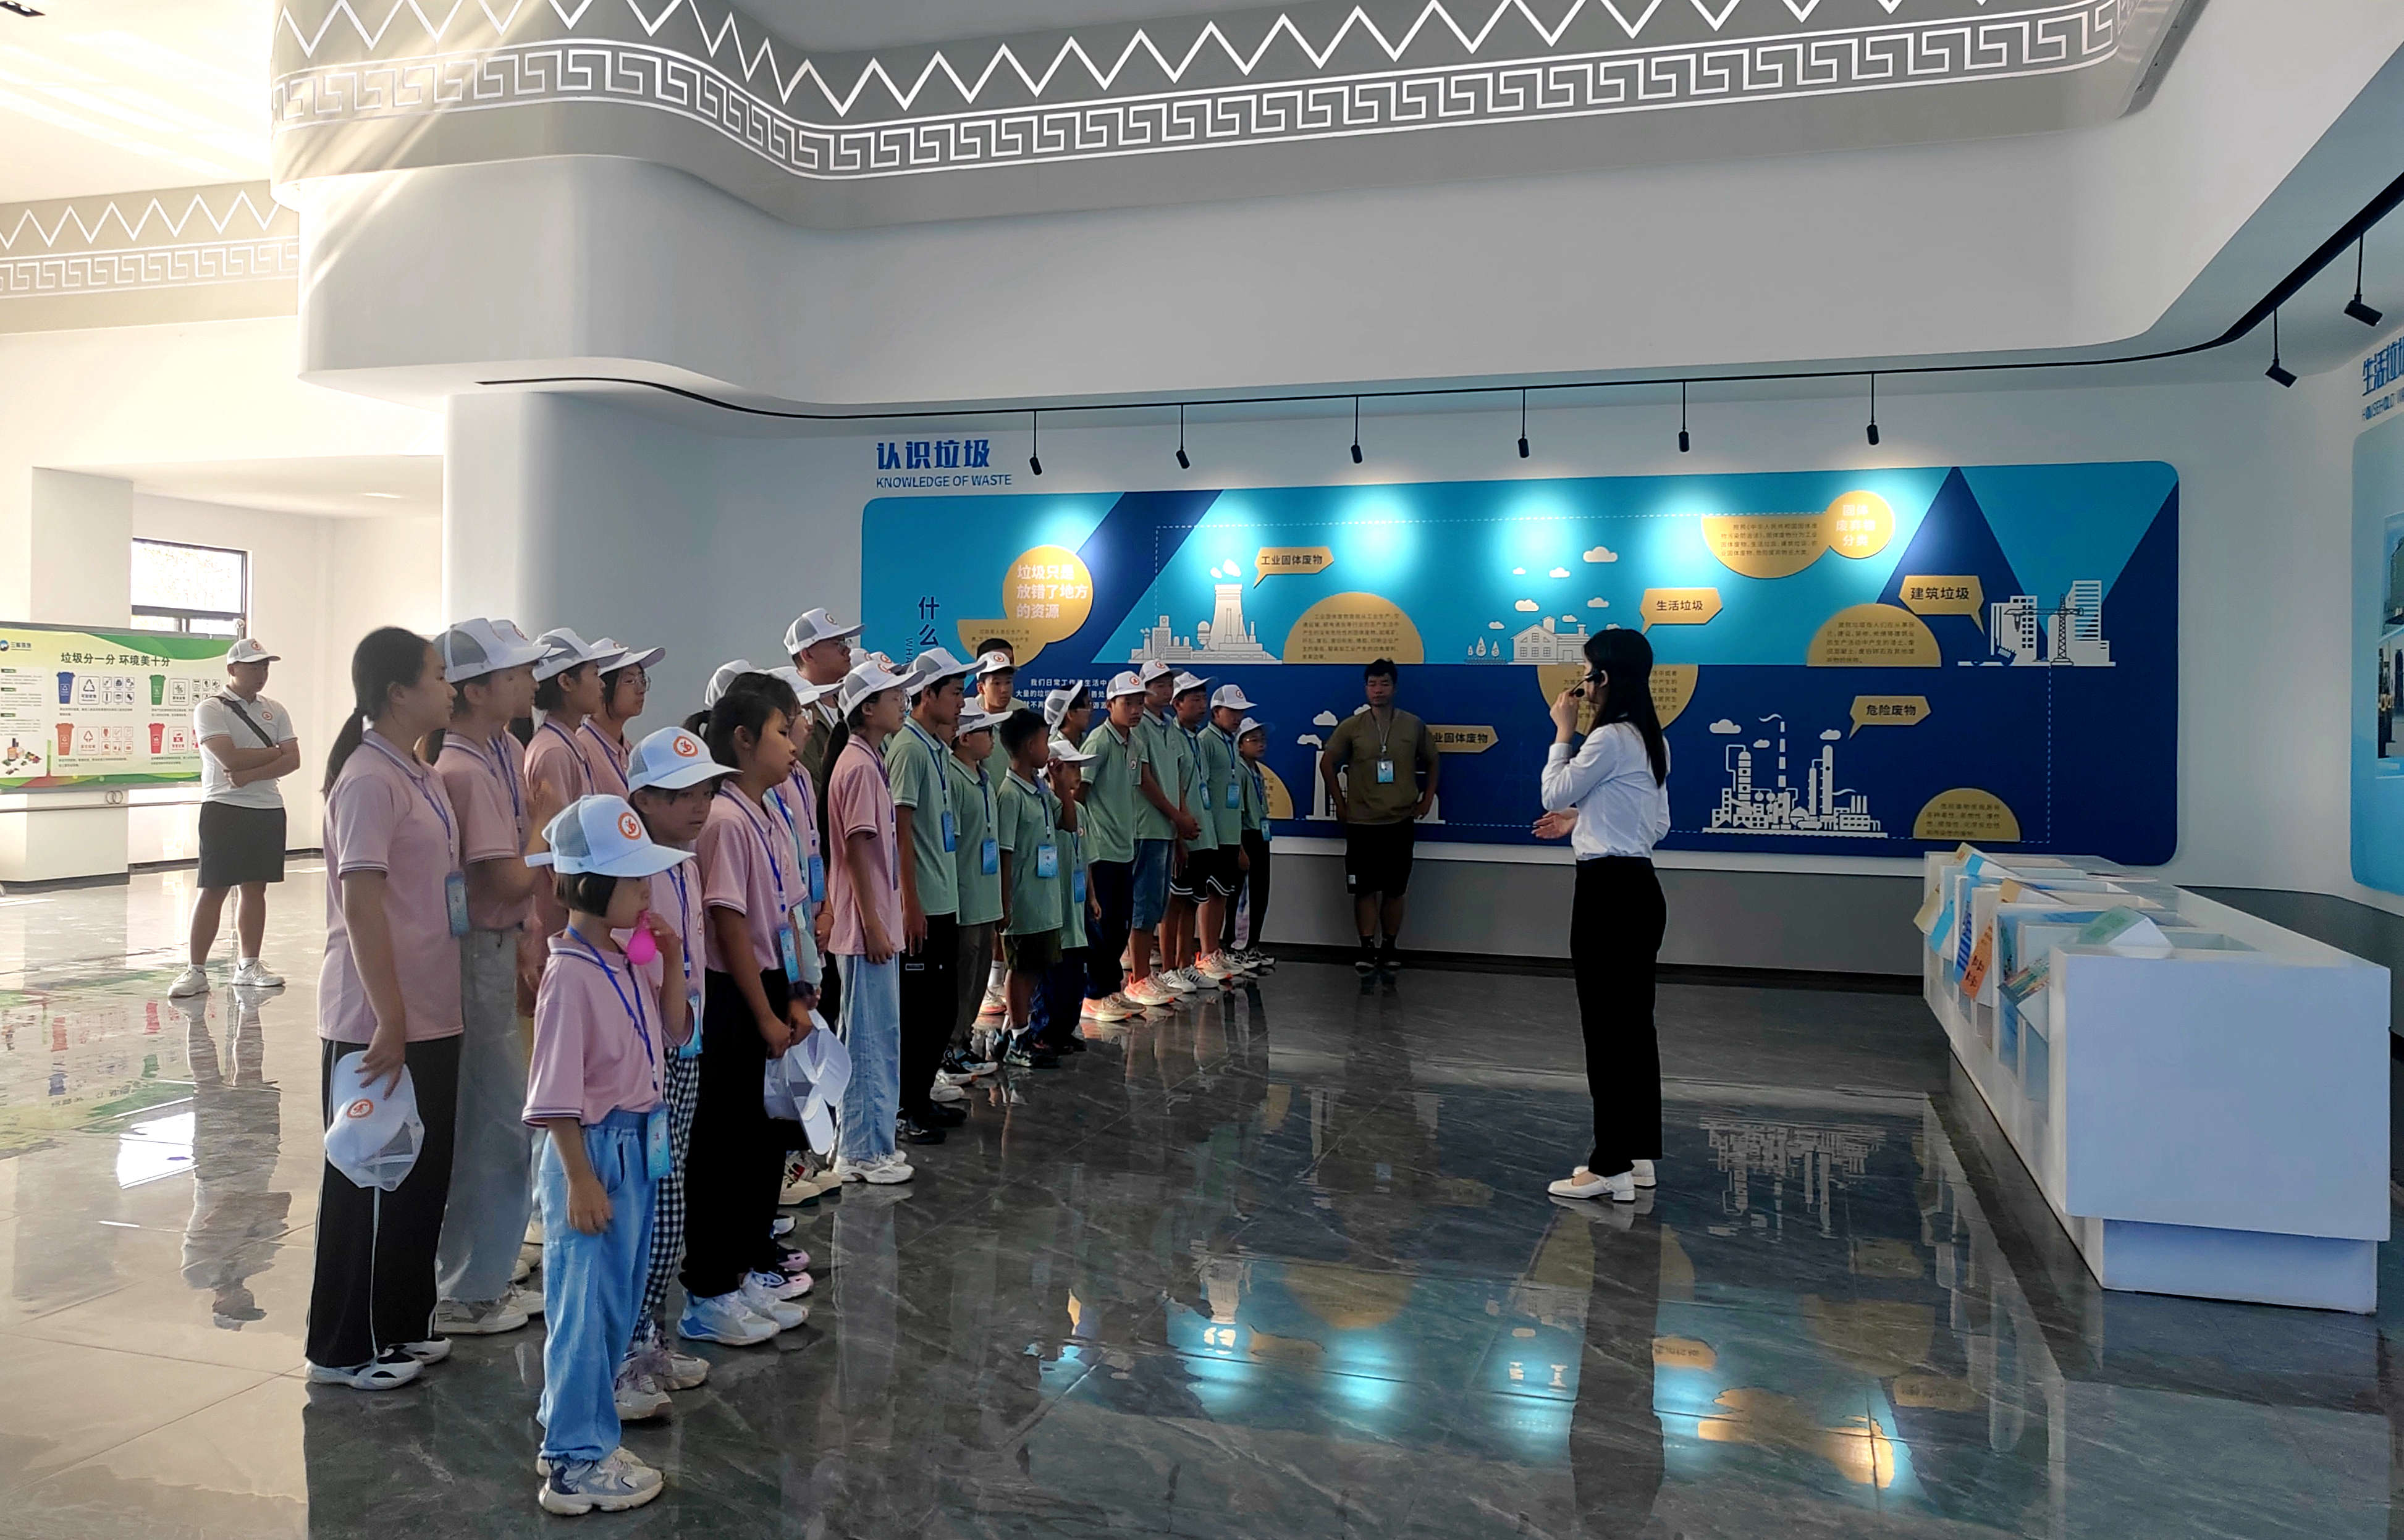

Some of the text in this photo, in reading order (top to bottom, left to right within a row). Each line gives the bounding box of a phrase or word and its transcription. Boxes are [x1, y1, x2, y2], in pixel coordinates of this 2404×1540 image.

[877, 439, 990, 469] 认识垃圾
[876, 474, 1012, 488] KNOWLEDGE OF WASTE
[1843, 534, 1869, 547] 分类
[1261, 554, 1323, 565] 工业固体废物
[1017, 565, 1074, 580] 垃圾只是
[1016, 584, 1089, 599] 放错了地方
[1910, 587, 1970, 600] 建筑垃圾
[1016, 604, 1060, 618] 的资源
[1656, 600, 1703, 611] 生活垃圾
[918, 596, 940, 646] 什么
[905, 637, 914, 663] WHA
[61, 652, 171, 667] 垃圾分一分 环境美十分
[1031, 678, 1107, 687] 我们日常工作生活中
[1866, 704, 1917, 716] 危险废物
[1433, 732, 1488, 743] 业固体废物
